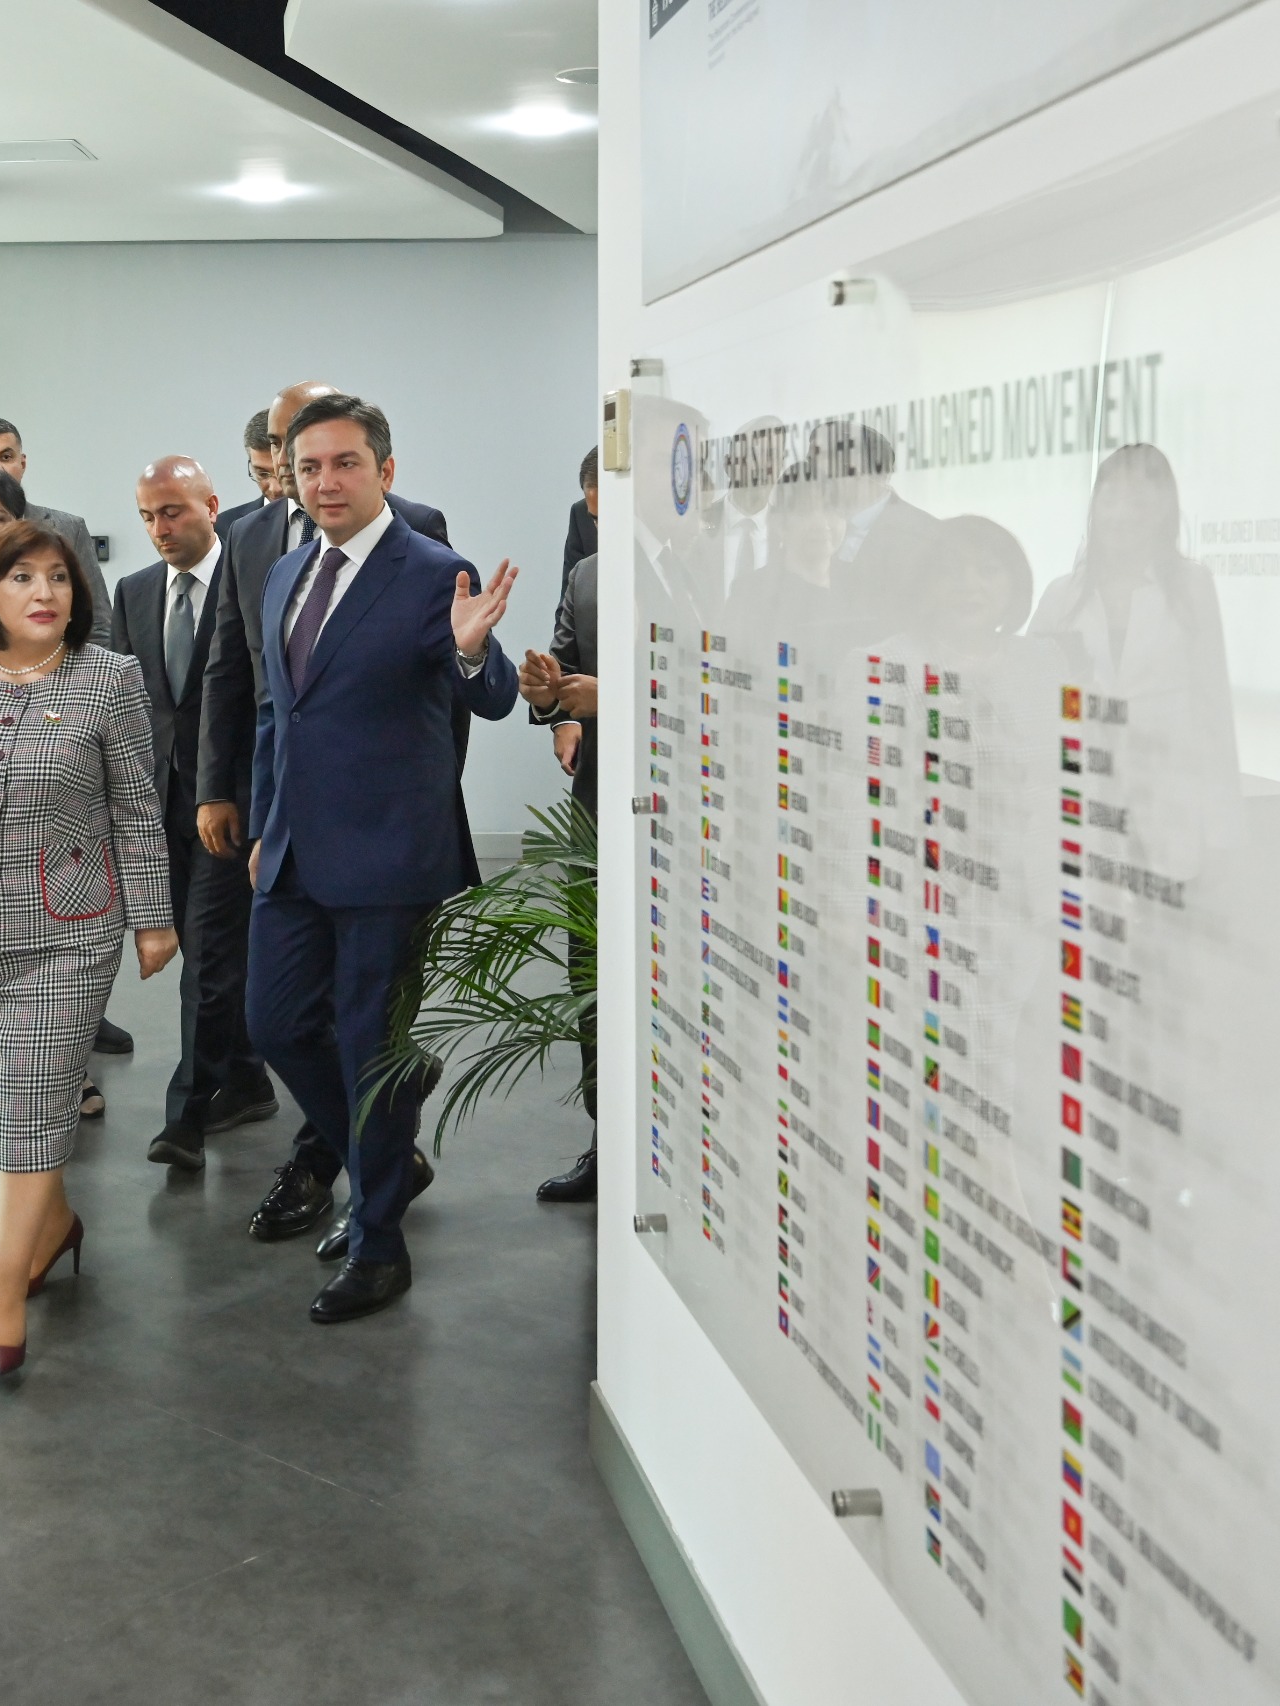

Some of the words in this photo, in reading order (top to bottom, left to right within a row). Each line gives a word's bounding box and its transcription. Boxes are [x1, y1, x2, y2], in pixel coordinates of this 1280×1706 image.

[751, 423, 798, 487] STATES
[803, 416, 821, 481] OF
[823, 411, 857, 479] THE
[861, 386, 994, 475] NON-ALIGNED
[1003, 351, 1164, 461] MOVEMENT
